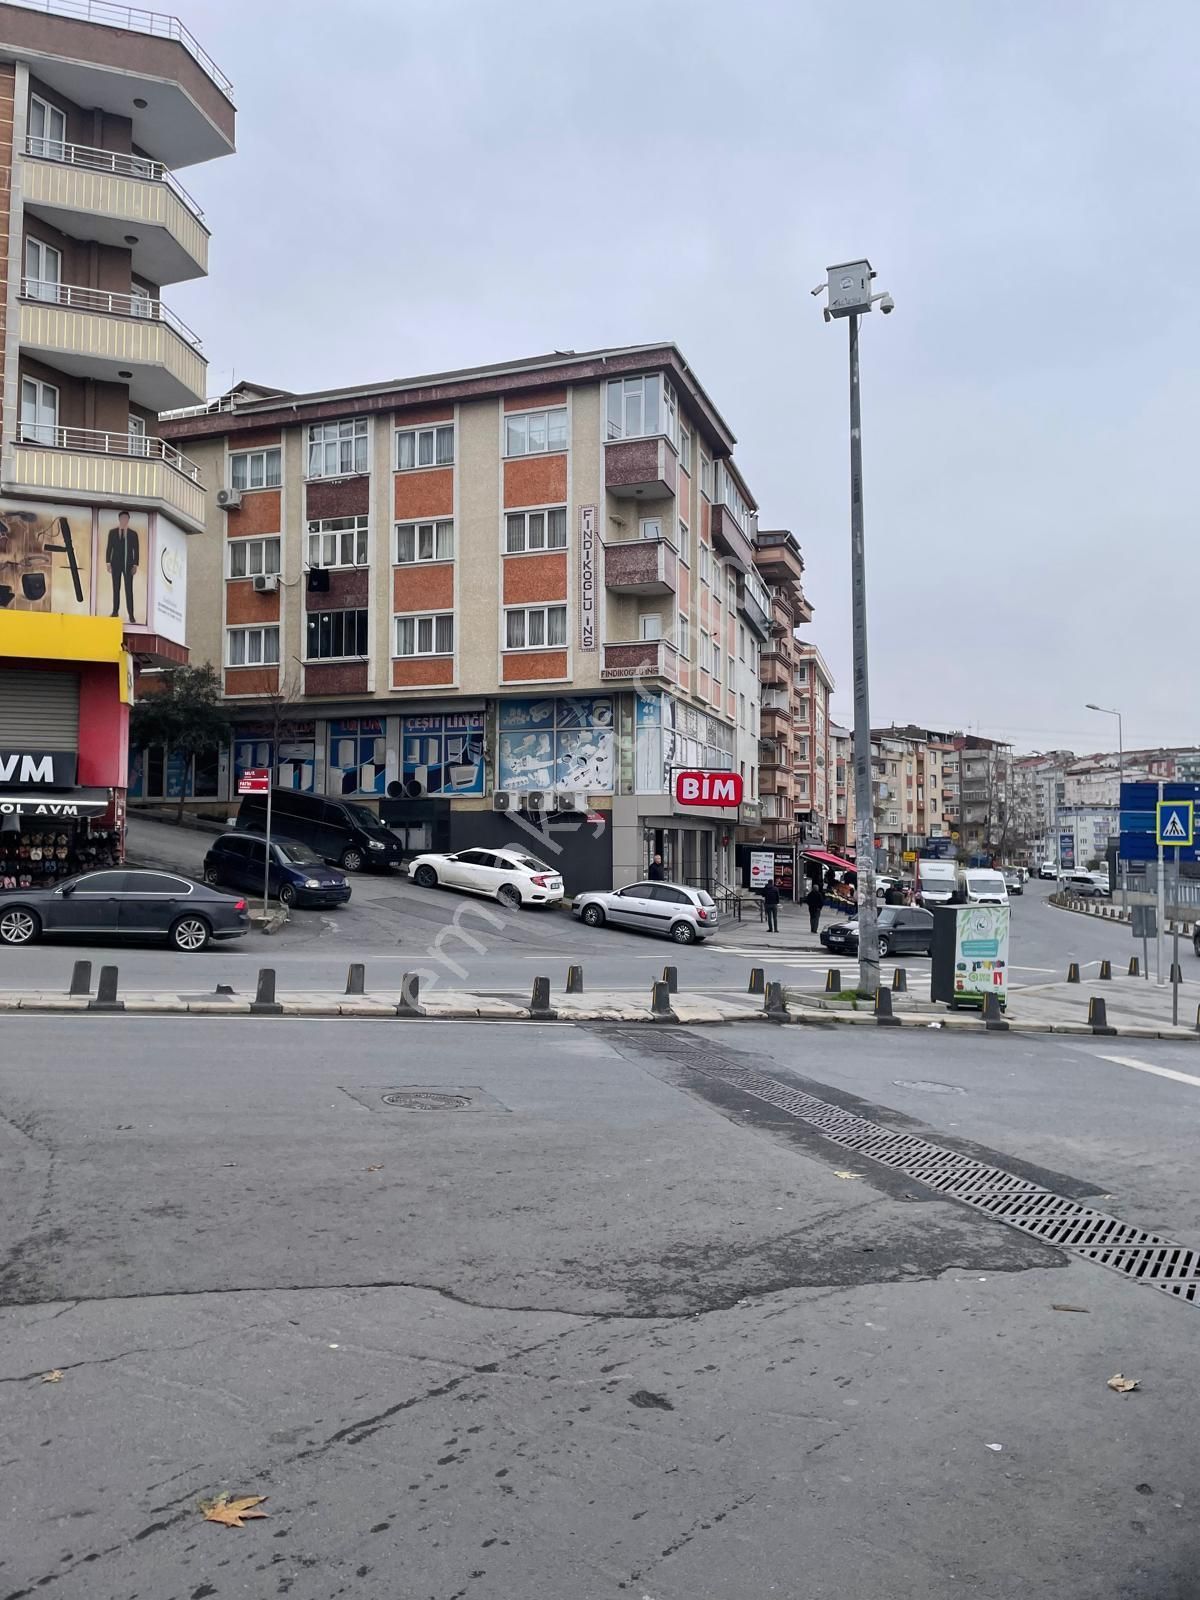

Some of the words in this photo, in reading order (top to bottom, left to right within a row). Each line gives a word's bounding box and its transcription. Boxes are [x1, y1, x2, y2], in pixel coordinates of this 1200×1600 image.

[583, 509, 593, 611] FINDIKOGLU
[682, 773, 735, 801] BİM
[35, 804, 78, 815] AVM
